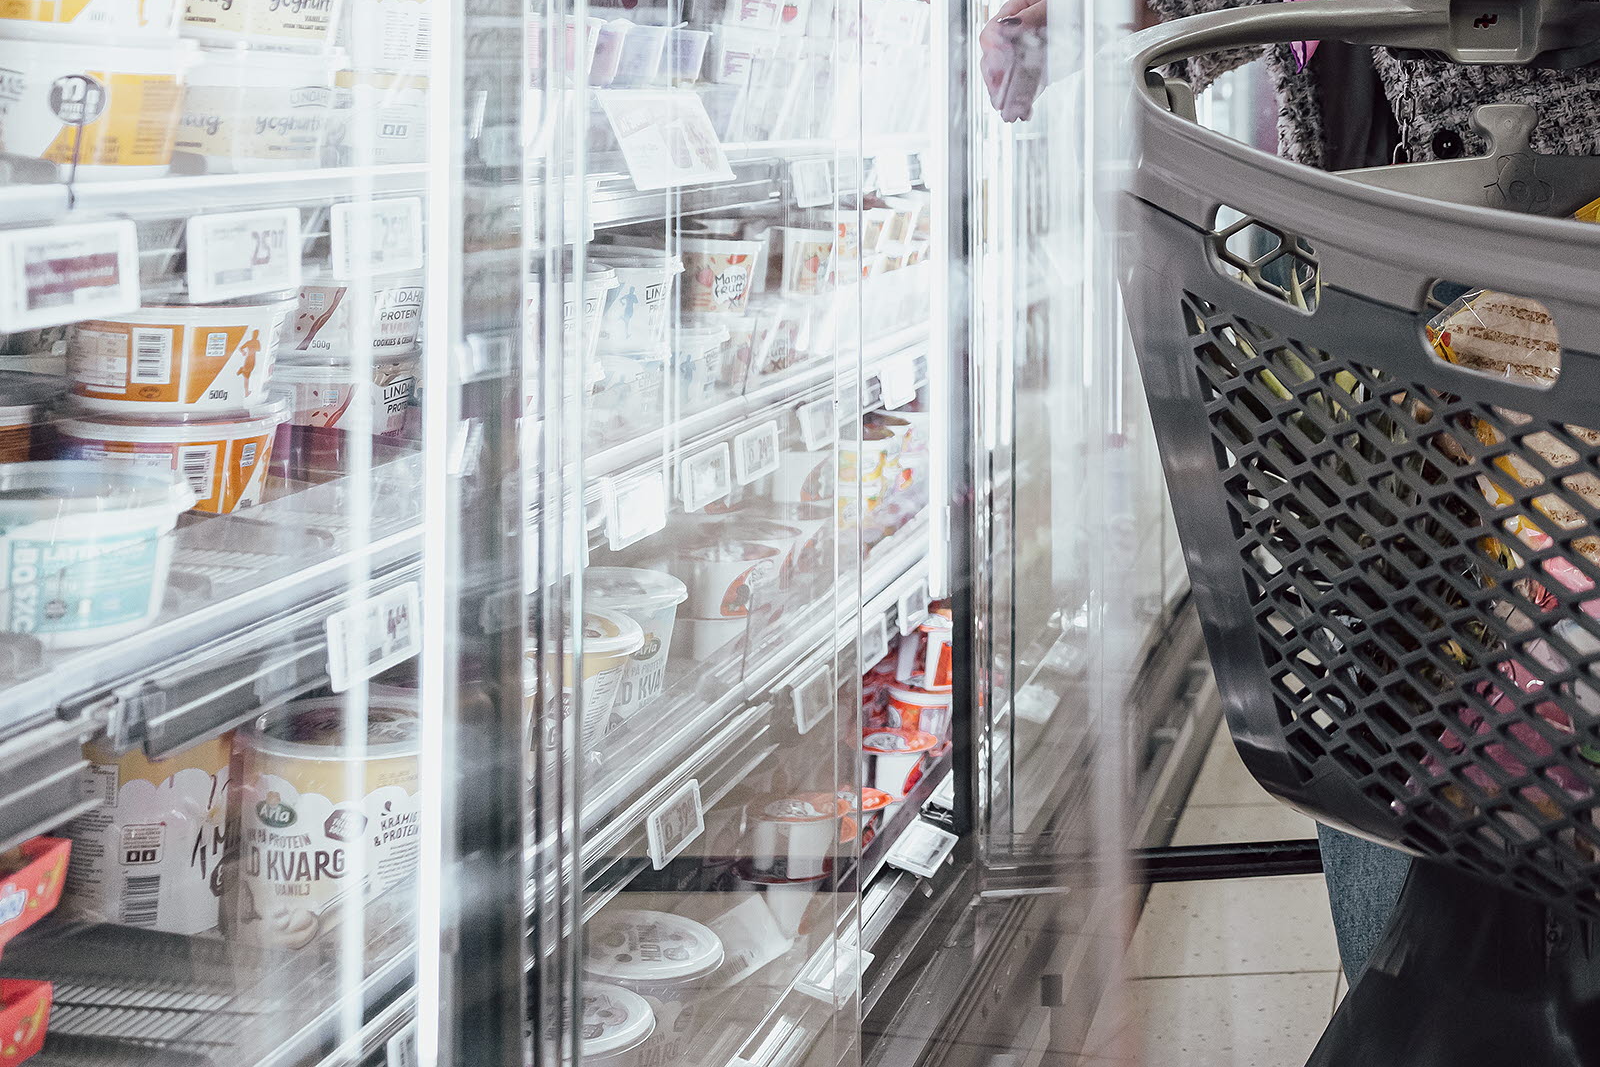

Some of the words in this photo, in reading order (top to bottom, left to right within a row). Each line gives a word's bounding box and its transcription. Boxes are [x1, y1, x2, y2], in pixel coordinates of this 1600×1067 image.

[380, 308, 419, 321] PROTEIN
[312, 340, 331, 350] 500g
[208, 389, 229, 401] 500g
[259, 806, 291, 823] Arla
[268, 833, 312, 849] PROTEIN
[266, 848, 346, 882] KVARG
